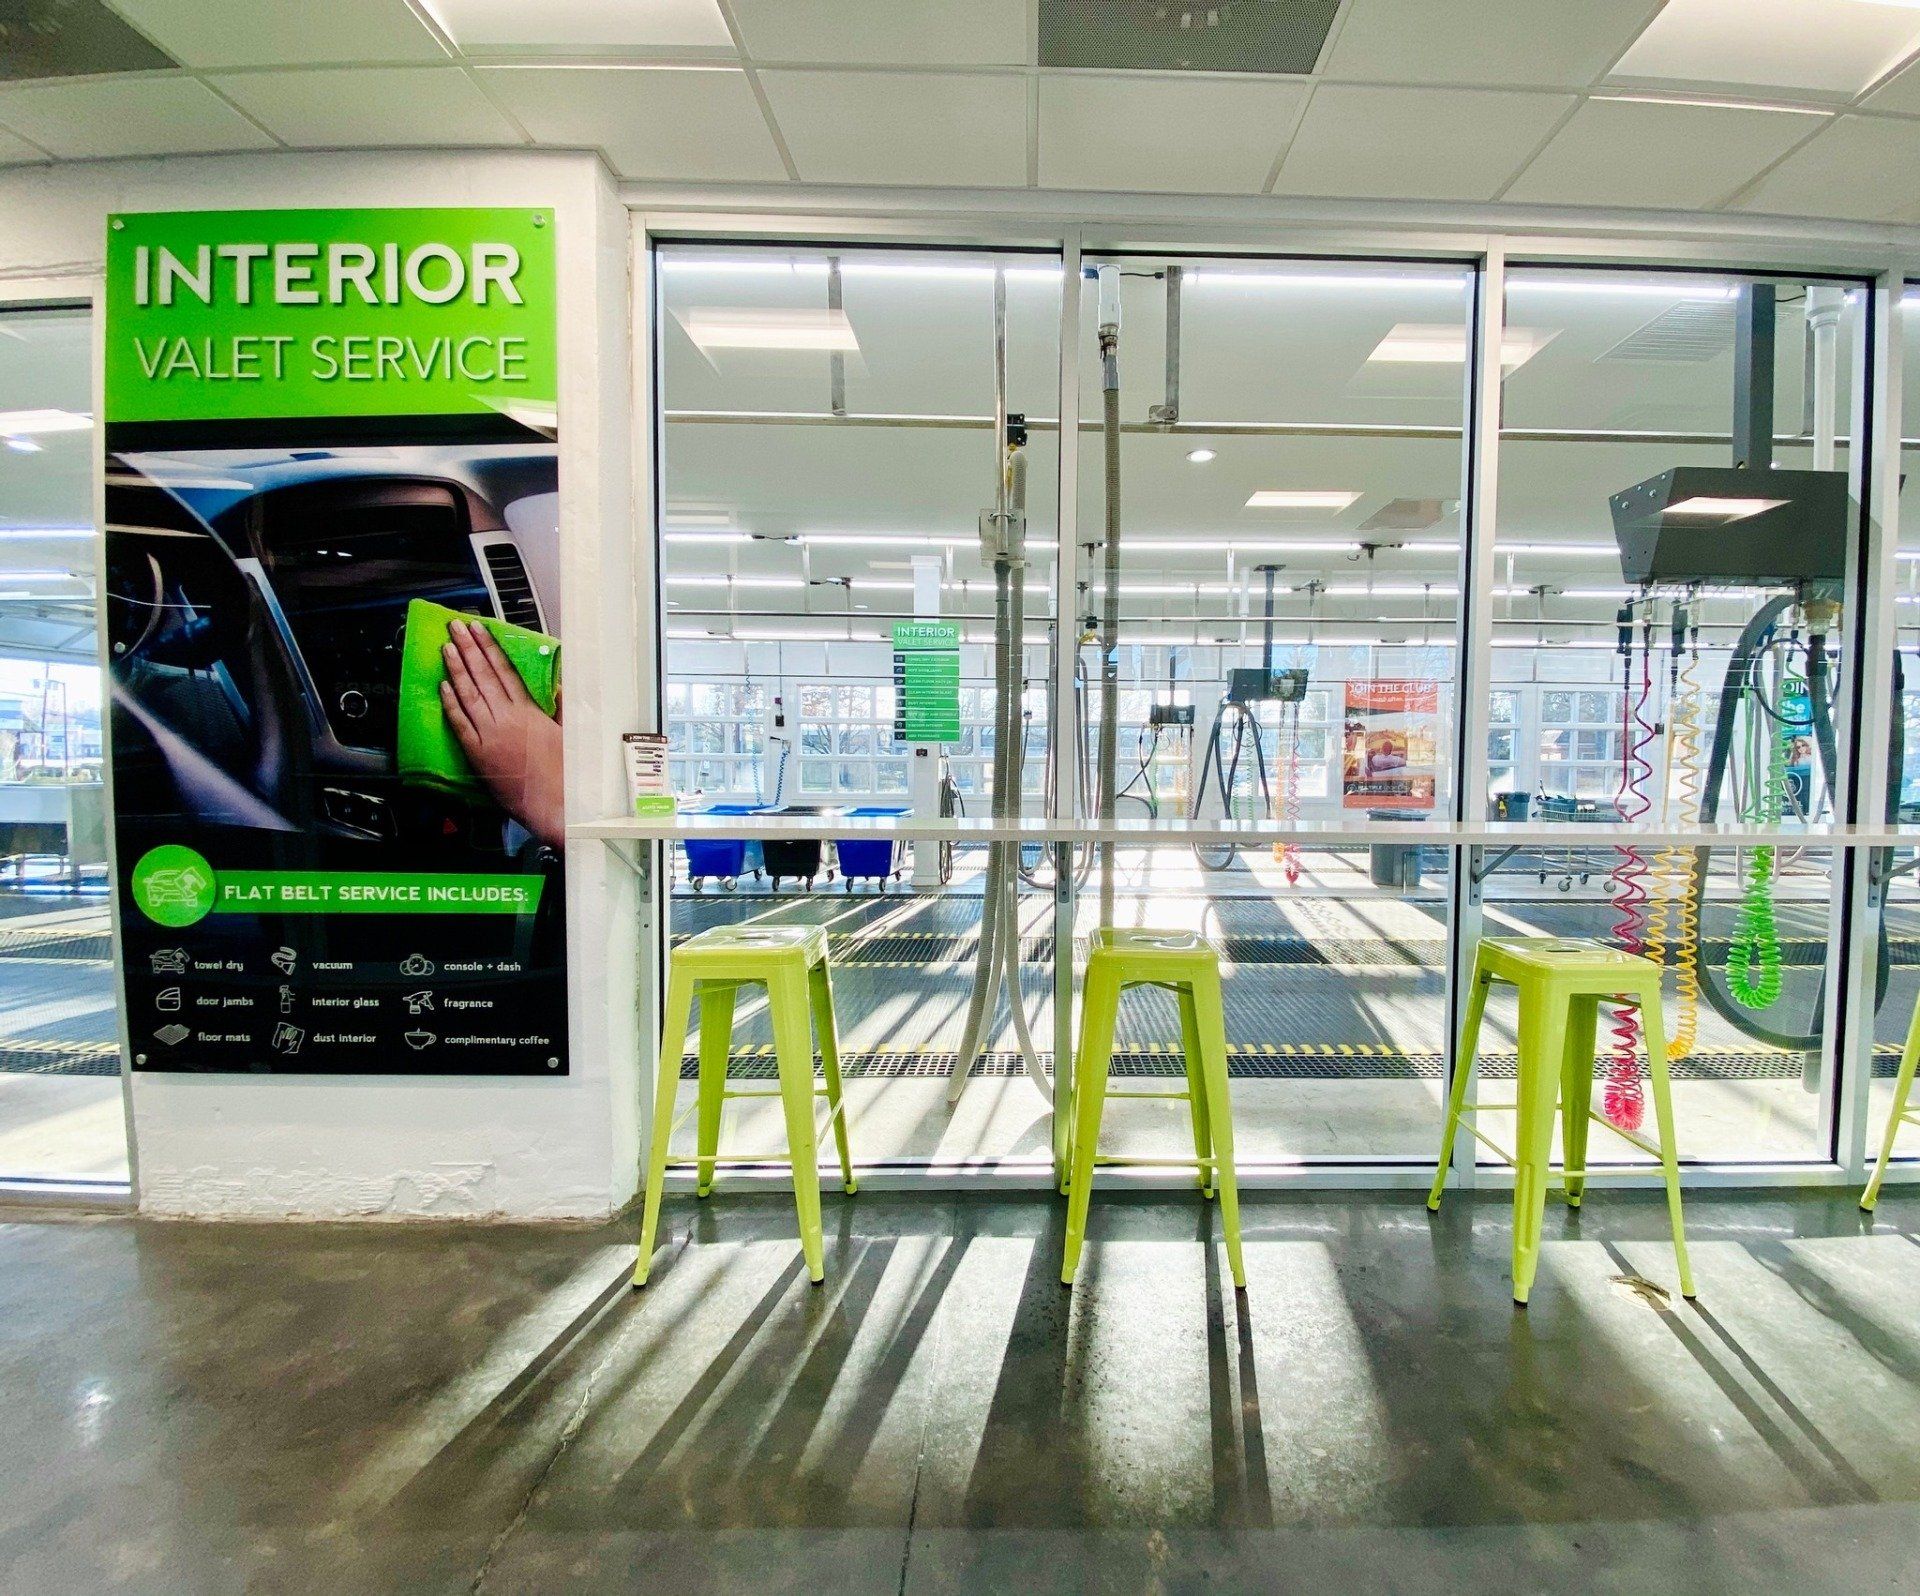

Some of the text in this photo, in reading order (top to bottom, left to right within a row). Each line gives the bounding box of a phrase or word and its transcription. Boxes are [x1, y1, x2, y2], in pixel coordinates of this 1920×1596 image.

[135, 243, 524, 304] INTERIOR
[134, 336, 527, 380] VALET SERVICE
[897, 626, 955, 638] INTERIOR
[897, 639, 924, 647] VALET
[1380, 683, 1400, 693] THE
[224, 885, 529, 902] FLAT BELT SERVICE INCLUDES:
[194, 960, 244, 972] towel dry
[312, 962, 353, 970] vacuum
[443, 961, 484, 971] console
[496, 961, 521, 972] dash
[196, 996, 254, 1008] door jambs
[312, 996, 380, 1009] interior glass
[443, 997, 494, 1010] fragrance
[197, 1031, 251, 1042] floor mats
[312, 1032, 377, 1043] dust interior
[444, 1035, 550, 1047] complimentary coffee
